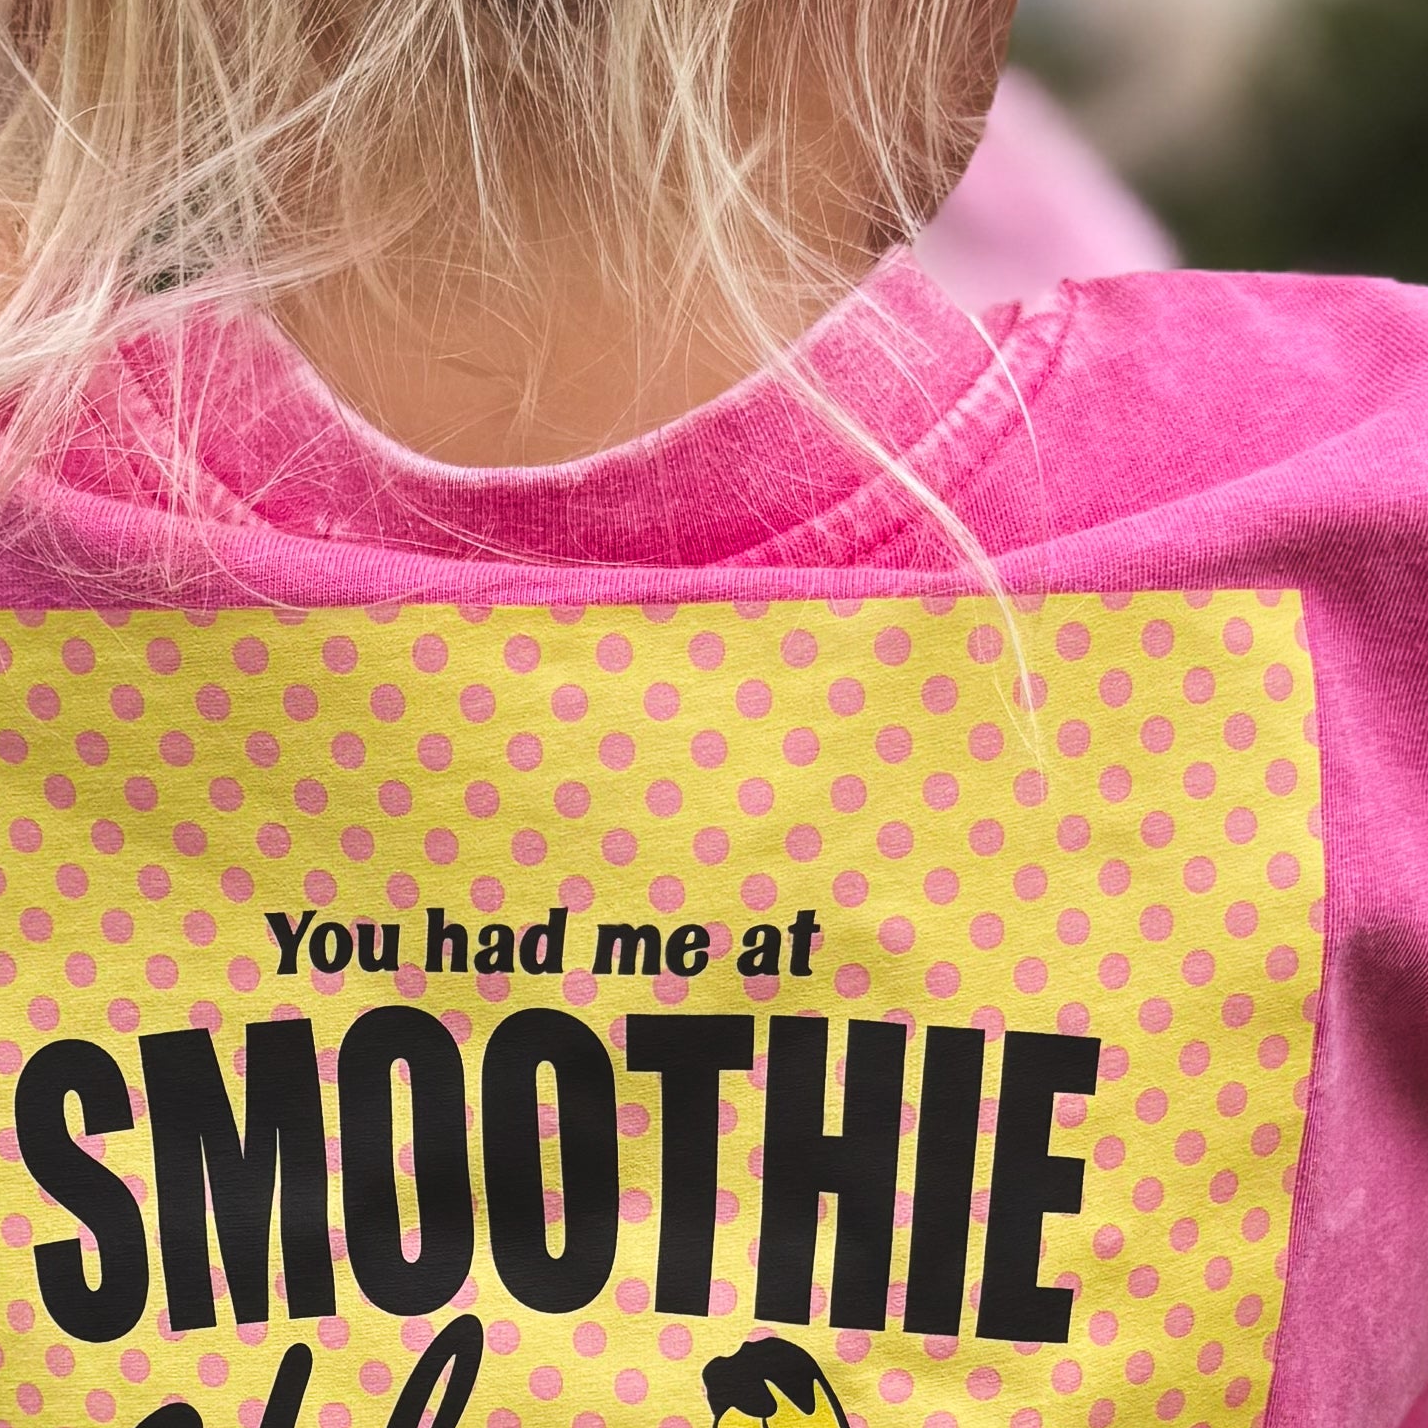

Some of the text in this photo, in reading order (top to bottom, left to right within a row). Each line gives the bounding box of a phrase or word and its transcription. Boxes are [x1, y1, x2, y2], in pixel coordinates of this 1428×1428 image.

[264, 907, 821, 977] You had me at
[13, 1005, 1102, 1344] SMOOTHIE
